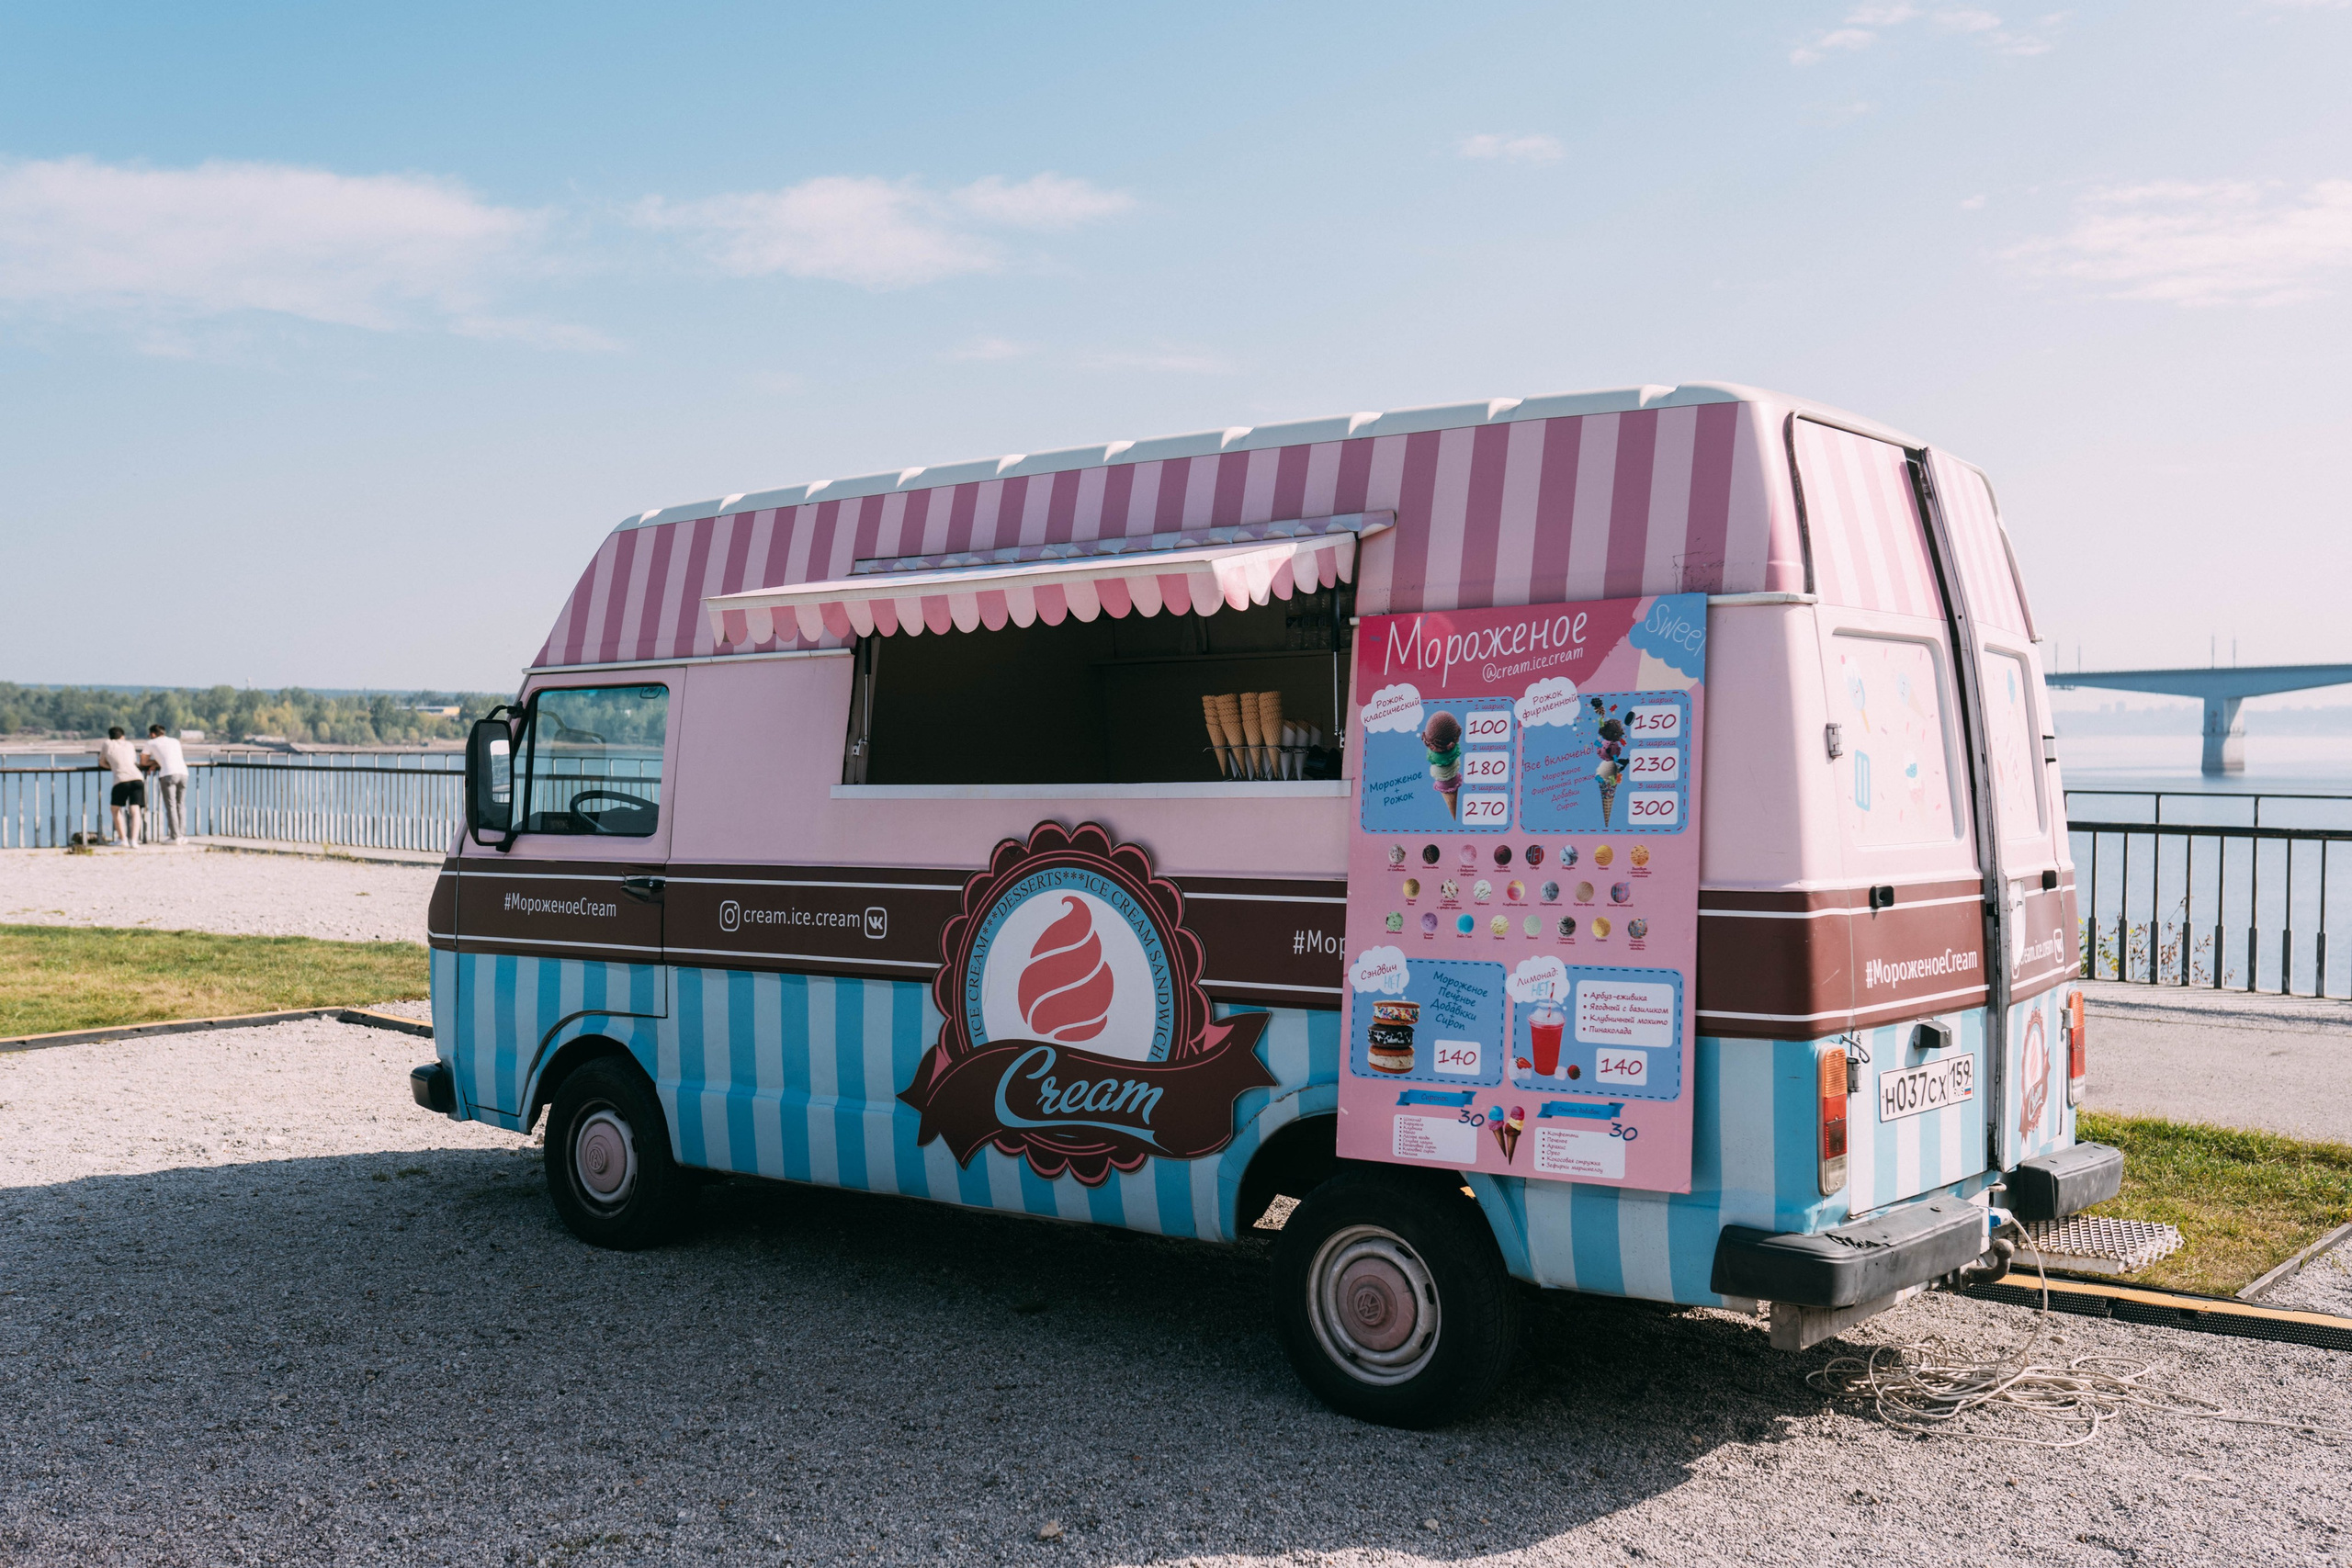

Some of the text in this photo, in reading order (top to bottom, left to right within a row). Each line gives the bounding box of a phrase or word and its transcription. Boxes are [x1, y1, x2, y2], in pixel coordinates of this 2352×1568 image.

[1384, 612, 1588, 688] Мороженое
[1483, 646, 1583, 682] @cream.ice.cream
[1376, 694, 1404, 709] Рожок
[1532, 690, 1563, 705] Рожок
[1648, 697, 1674, 705] шарик
[1363, 696, 1419, 724] классический
[1481, 704, 1505, 712] шарик
[1522, 694, 1577, 719] фирменный
[1468, 719, 1508, 735] 100
[1634, 714, 1677, 729] 150
[1479, 744, 1507, 752] шарика
[1524, 743, 1595, 773] Все включено!
[1632, 756, 1676, 773] 230
[1467, 761, 1506, 775] 180
[1542, 766, 1581, 782] Мороженое
[1369, 771, 1422, 793] Мороженое
[1478, 784, 1506, 793] шарика
[1531, 781, 1572, 795] Фирменный
[1383, 792, 1414, 807] Рожок
[1552, 789, 1580, 803] Добавки
[1464, 801, 1505, 817] 270
[1555, 801, 1578, 812] Сироп
[1632, 800, 1674, 816] 300
[503, 892, 616, 917] #МороженоеCream
[743, 907, 861, 929] cream.ice.cream
[968, 871, 1170, 1061] ICE CREAM DESSERTS ICE CREAM SANDWICH
[1361, 964, 1397, 980] Сэндвич
[1865, 948, 1978, 989] #МороженоеCream
[1384, 973, 1402, 990] НЕТ
[1433, 971, 1488, 998] Мороженое
[1517, 967, 1559, 987] Лимонад:
[1438, 987, 1476, 1007] Печенье
[1531, 980, 1550, 997] НЕТ
[1430, 998, 1477, 1021] Добавкки
[1589, 1003, 1620, 1011] Ягодный
[1629, 1004, 1669, 1014] базиликом
[1435, 1013, 1465, 1031] Сироп
[1589, 1014, 1634, 1024] Клубничный
[1589, 1025, 1632, 1035] Пинаколада
[1438, 1049, 1476, 1066] 140
[1600, 1058, 1643, 1076] 140
[1950, 1059, 1970, 1088] 159
[995, 1045, 1173, 1155] Cream
[1458, 1109, 1485, 1127] 30
[1609, 1122, 1638, 1141] 30
